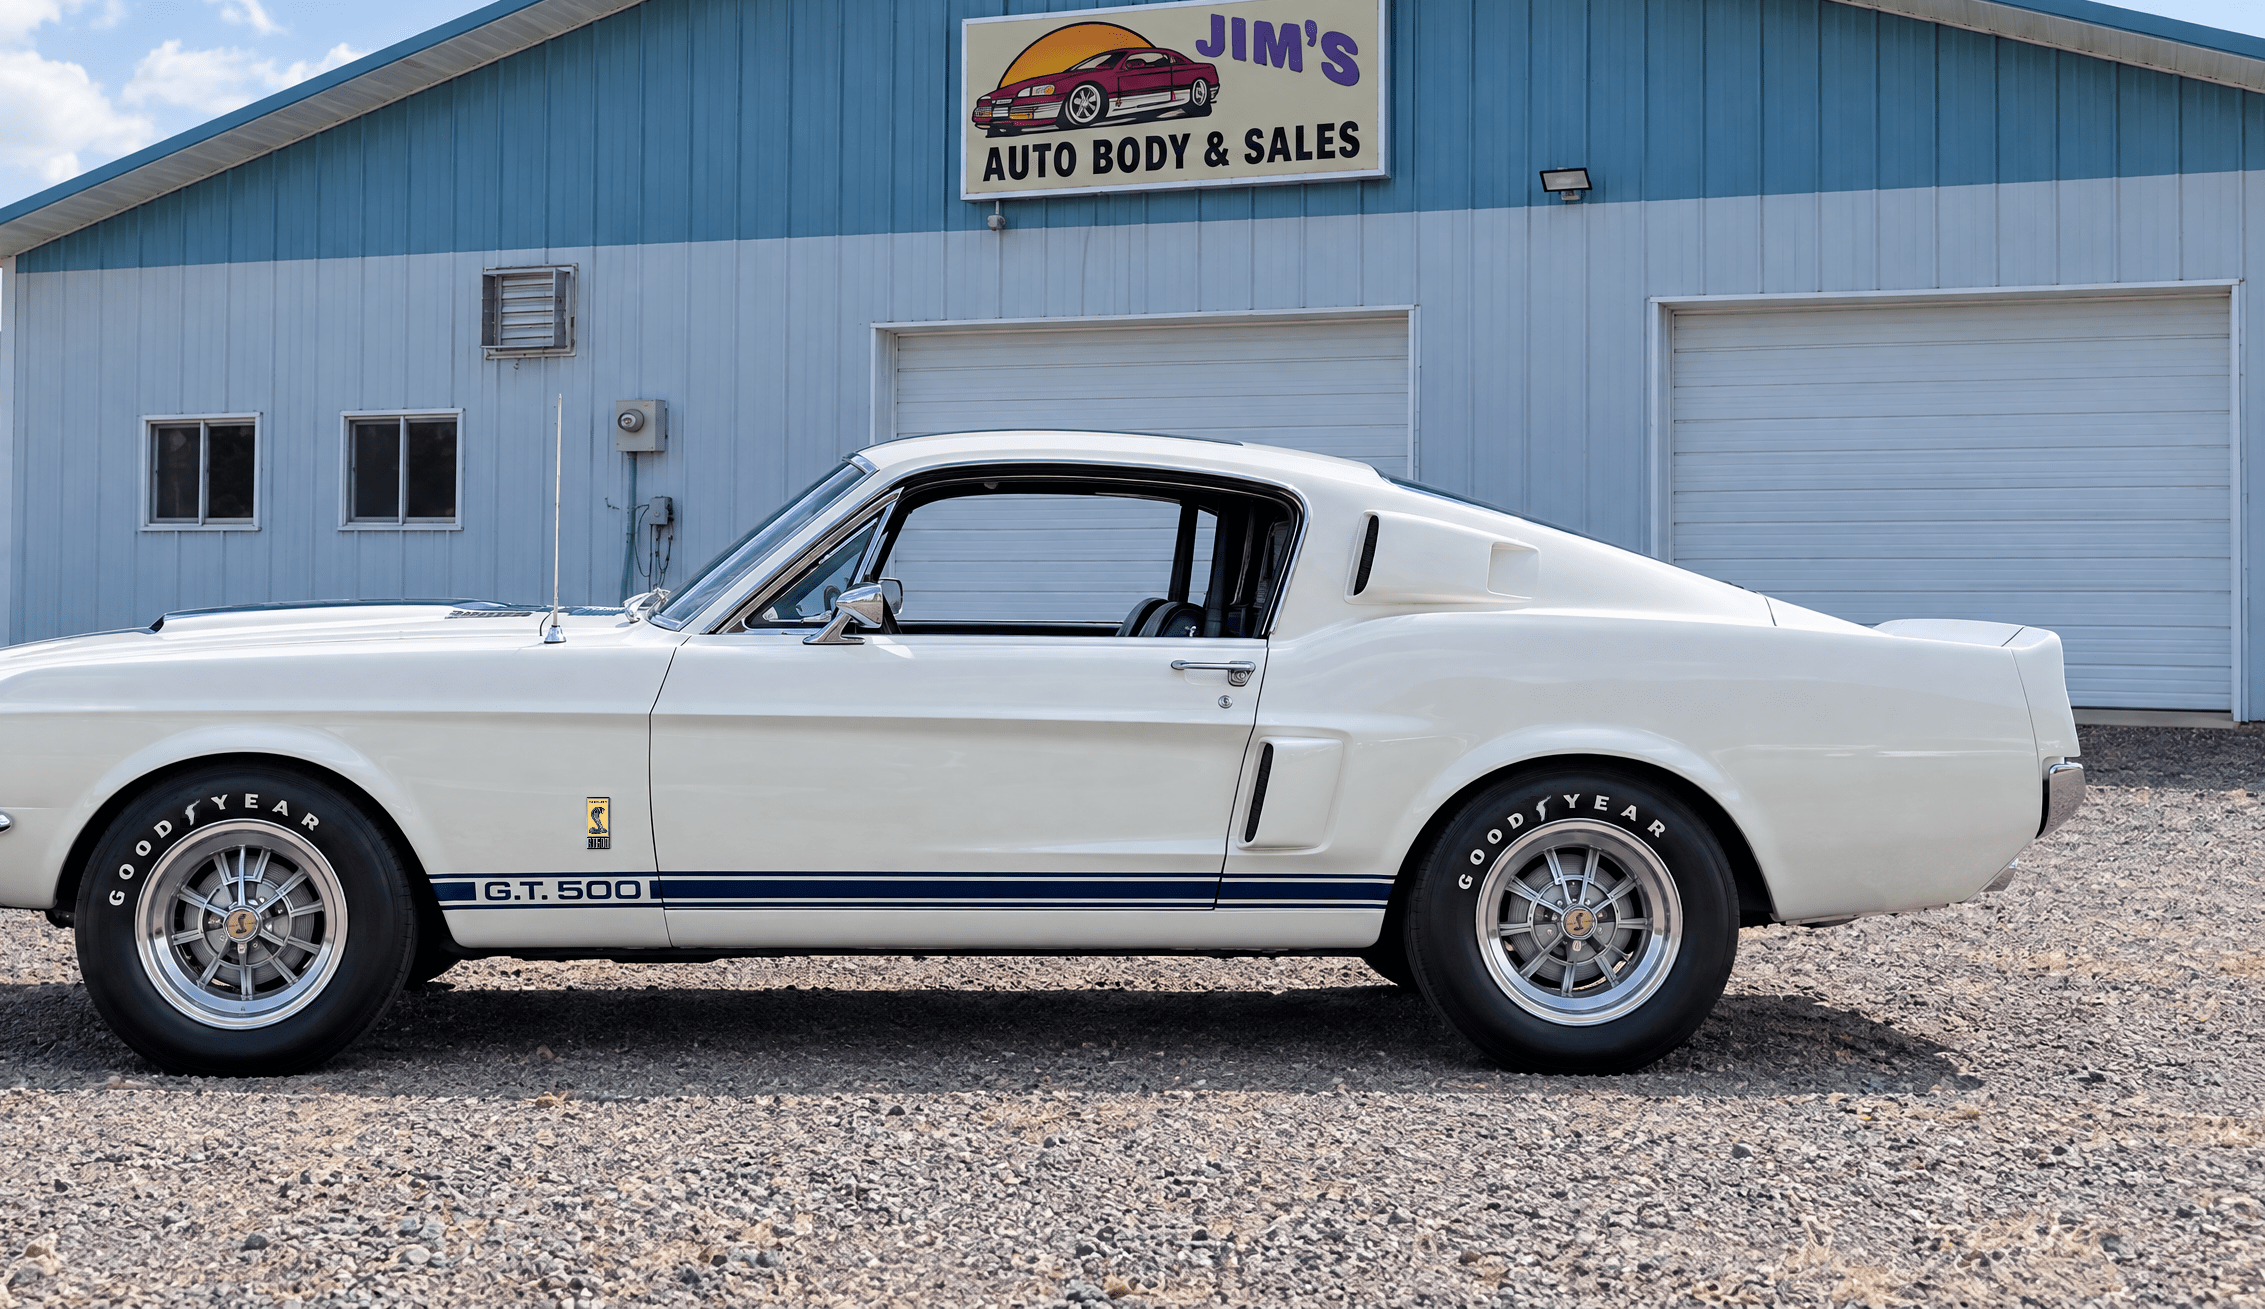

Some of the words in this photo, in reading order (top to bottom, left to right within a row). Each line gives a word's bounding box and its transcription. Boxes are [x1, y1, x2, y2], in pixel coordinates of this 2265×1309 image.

[1195, 13, 1359, 86] JIM'S
[982, 141, 1077, 182] AUTO
[1092, 132, 1191, 175] BODY
[1203, 130, 1230, 168] &
[1244, 120, 1361, 165] SALES
[484, 881, 549, 901] G.T.
[557, 880, 642, 900] 500
